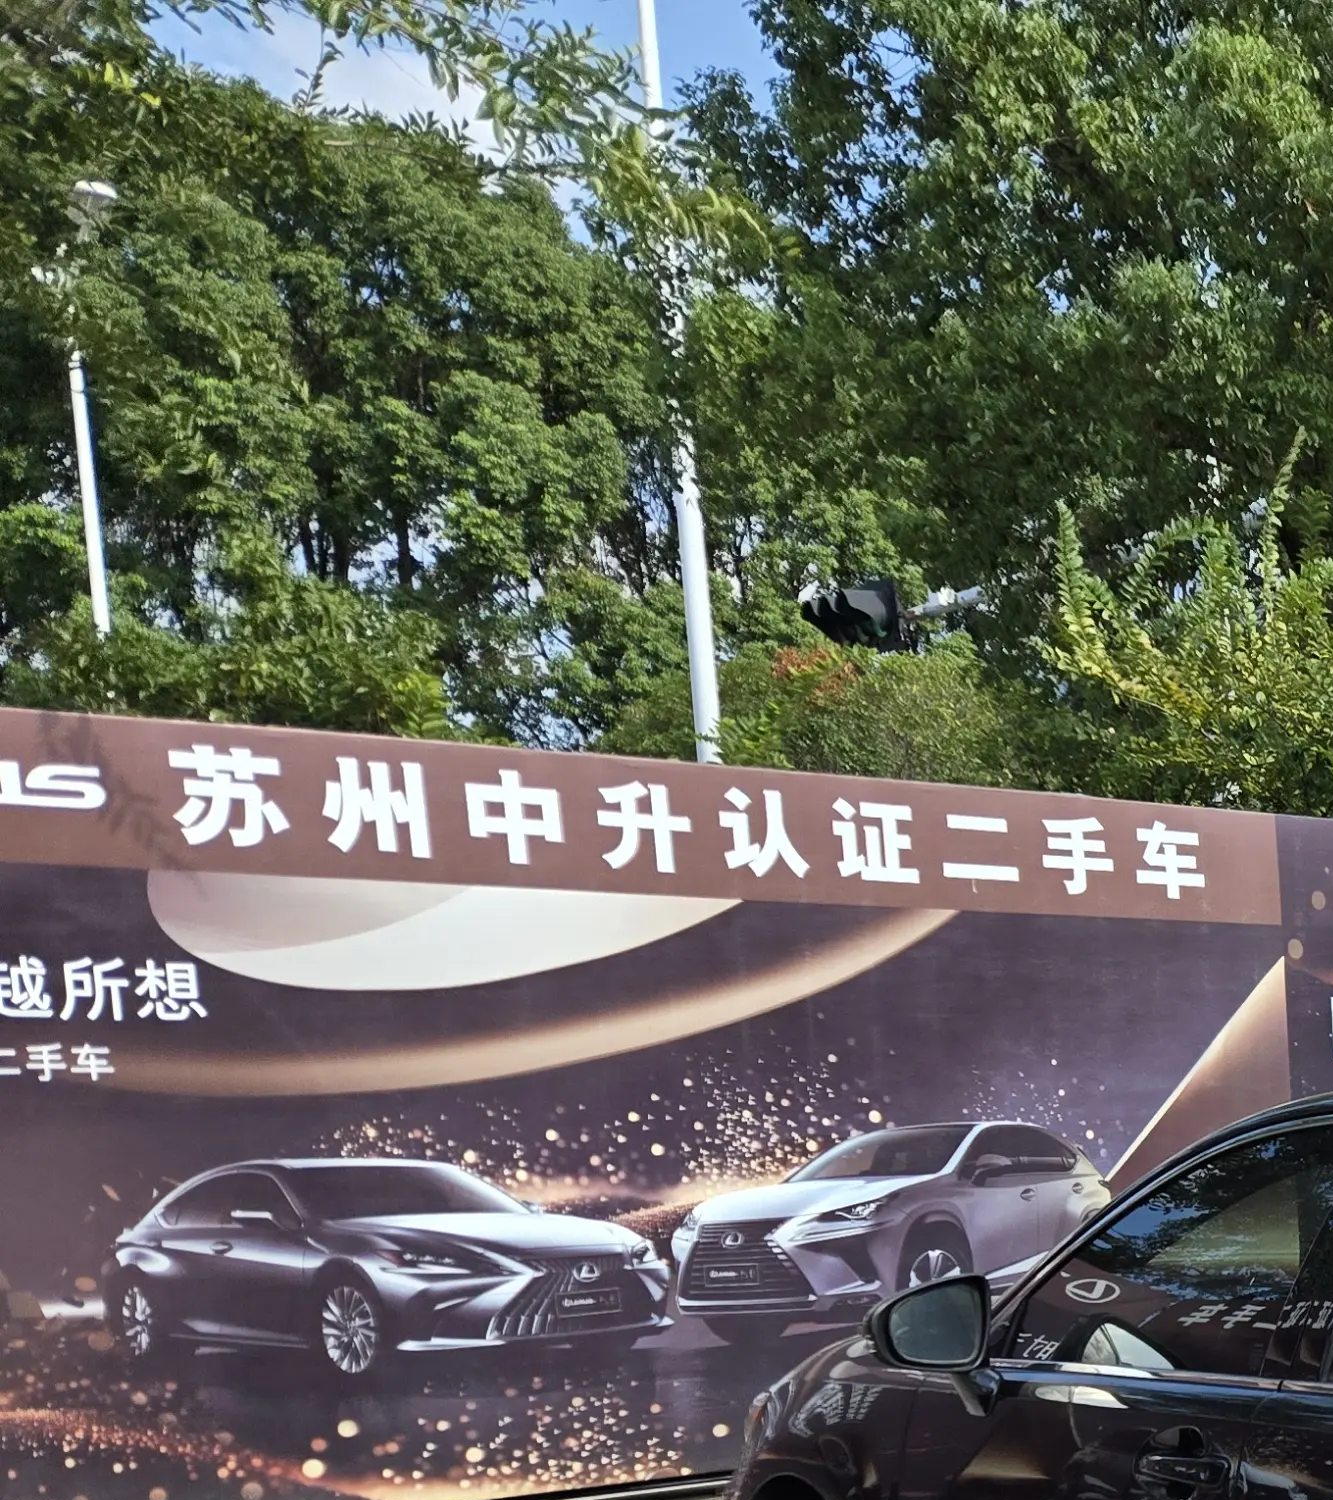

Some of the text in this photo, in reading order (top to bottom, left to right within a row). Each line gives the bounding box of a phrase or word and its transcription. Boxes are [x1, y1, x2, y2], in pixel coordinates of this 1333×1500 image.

[168, 744, 1206, 899] 苏州中升认证二手车
